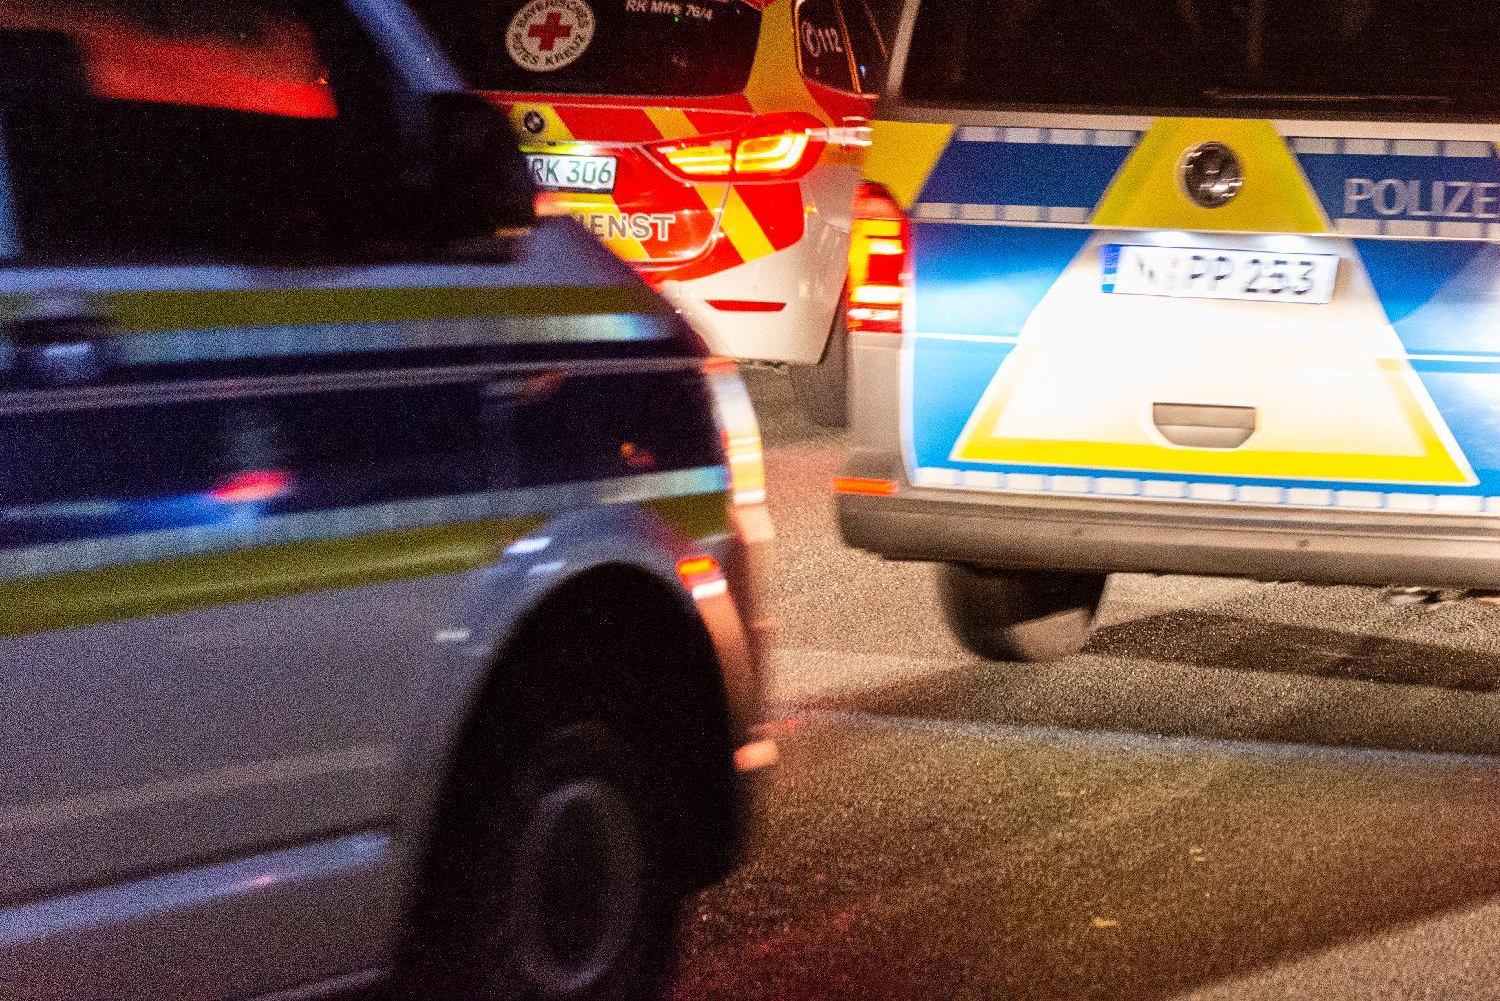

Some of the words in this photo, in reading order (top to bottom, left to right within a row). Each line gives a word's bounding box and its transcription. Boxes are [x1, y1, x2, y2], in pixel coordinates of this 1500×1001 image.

[818, 28, 843, 53] 112
[566, 160, 612, 185] 306
[1182, 255, 1233, 290] PP
[1242, 258, 1315, 295] 253
